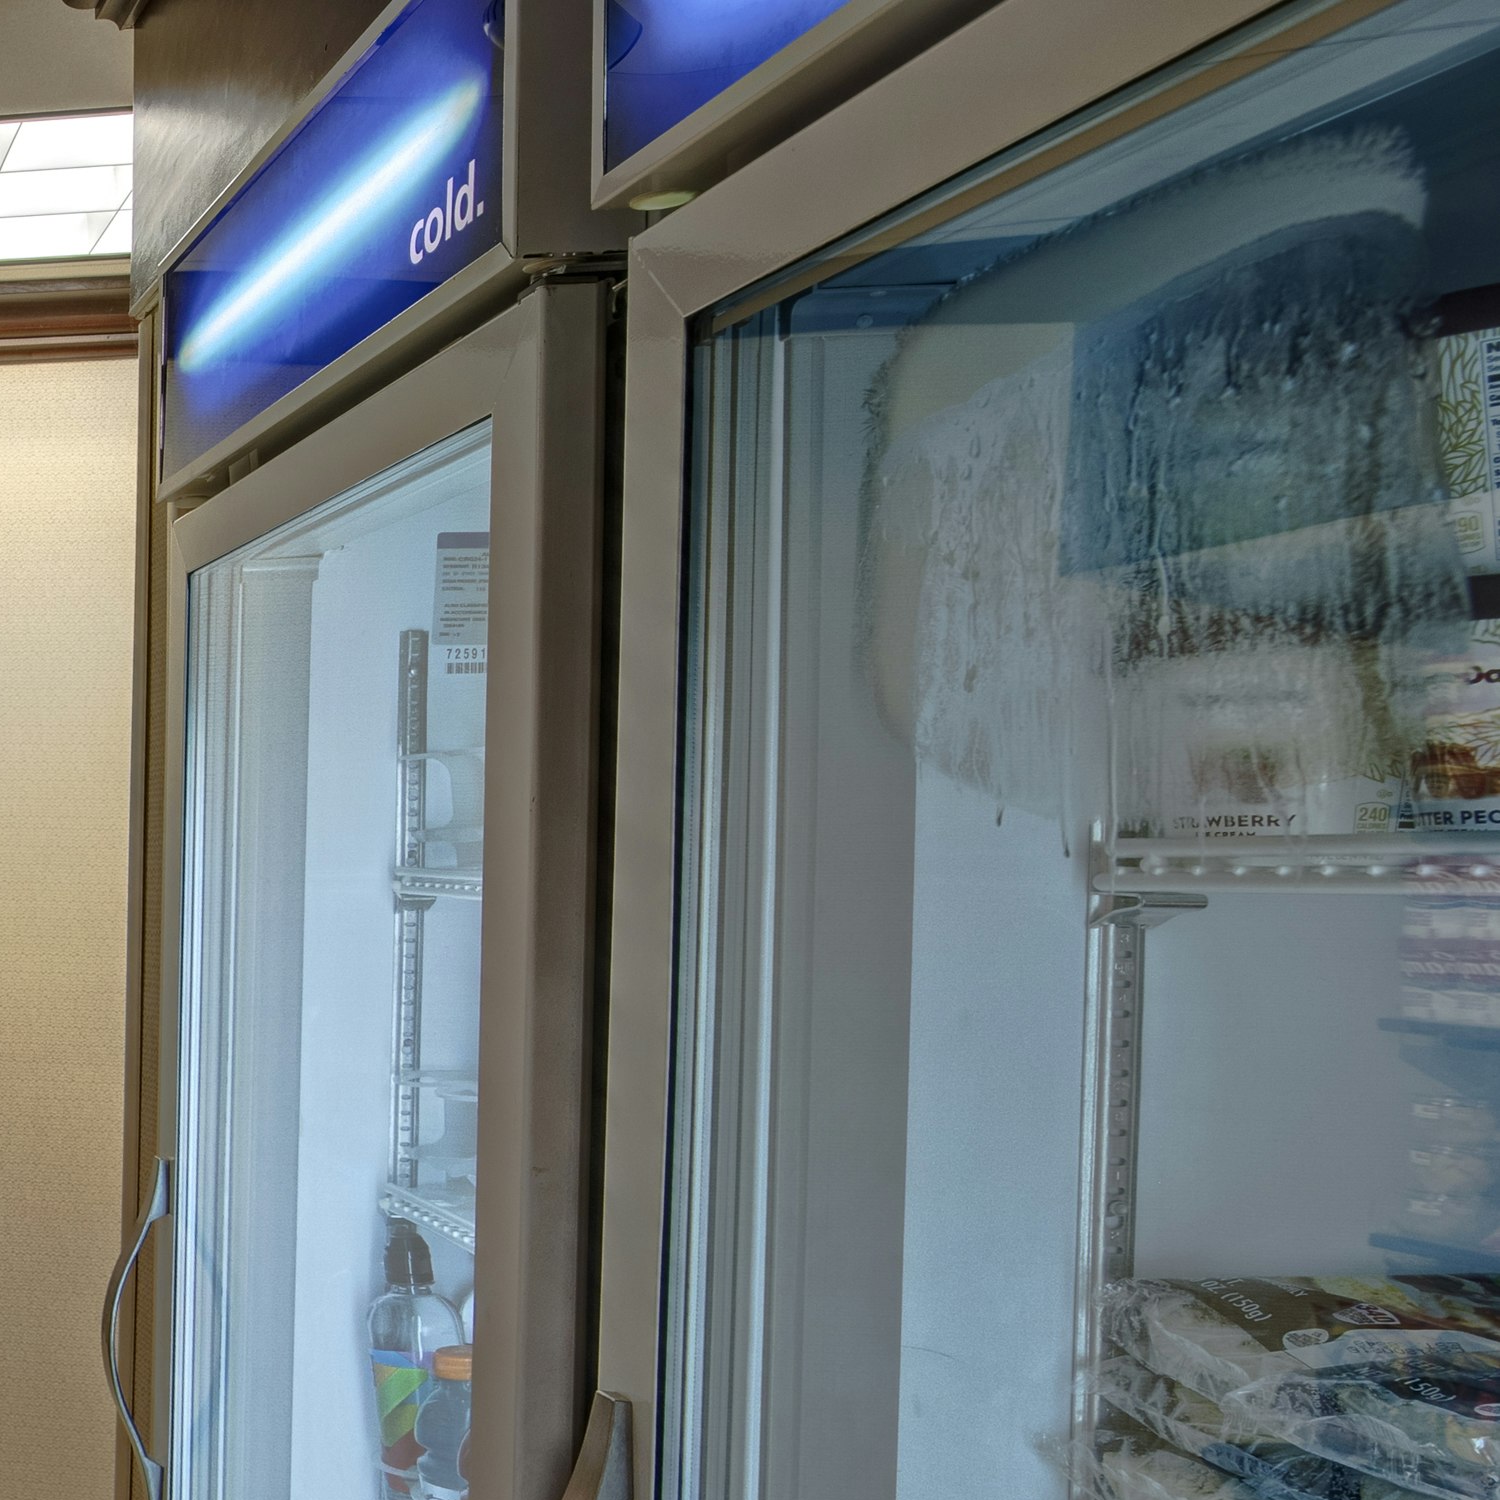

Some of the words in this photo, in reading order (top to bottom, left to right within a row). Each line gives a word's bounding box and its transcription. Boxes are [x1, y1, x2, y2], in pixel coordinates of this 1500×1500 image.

[409, 159, 485, 264] cold.
[445, 647, 487, 660] 72591
[1173, 813, 1297, 831] STRAWBERRY
[1358, 806, 1388, 822] 240
[1200, 1279, 1221, 1295] OZ.
[1221, 1292, 1273, 1323] (150g)
